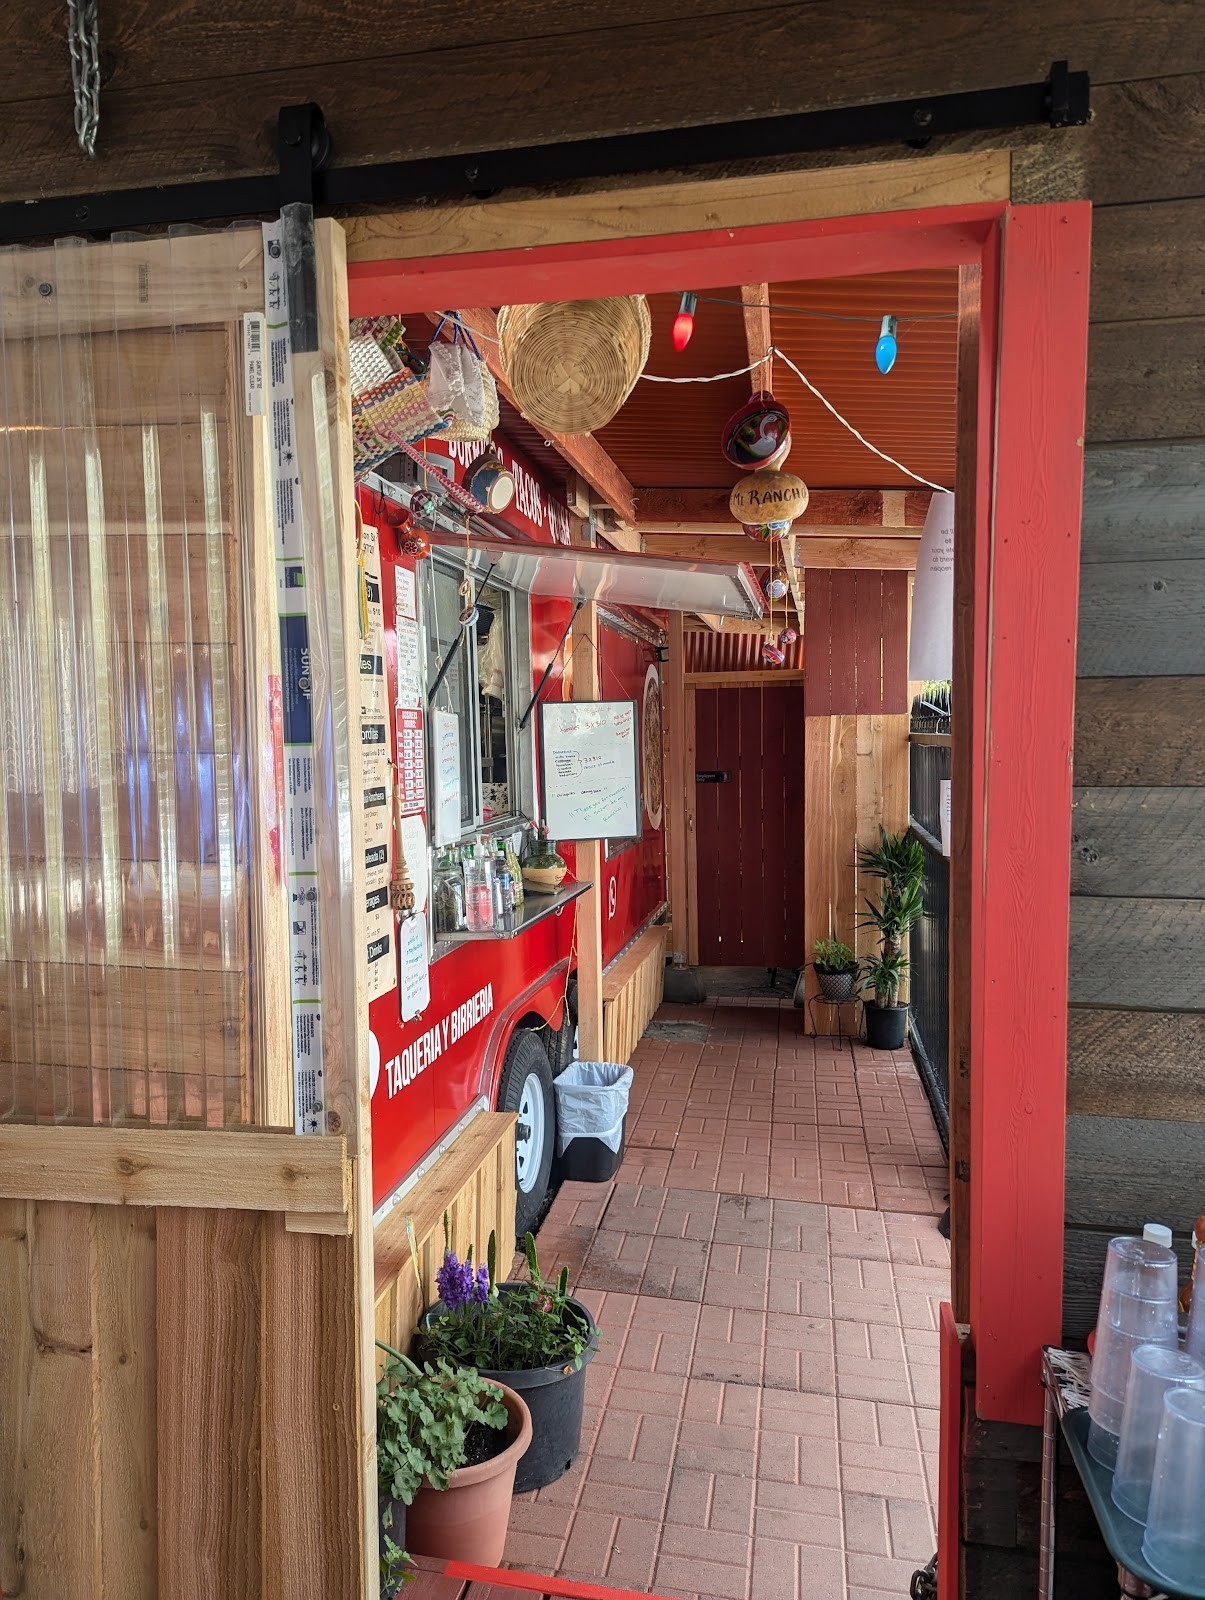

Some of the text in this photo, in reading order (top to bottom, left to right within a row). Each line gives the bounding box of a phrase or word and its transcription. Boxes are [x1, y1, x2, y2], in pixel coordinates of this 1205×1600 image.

[511, 459, 543, 528] TACOS
[748, 487, 807, 506] RANCHO
[361, 728, 379, 740] orditas
[366, 851, 378, 864] aleada
[366, 893, 380, 908] erages
[369, 942, 382, 958] Drinks
[385, 1023, 442, 1099] TAQUERIA
[442, 1015, 449, 1051] Y
[451, 982, 493, 1045] BIRRIERIA
